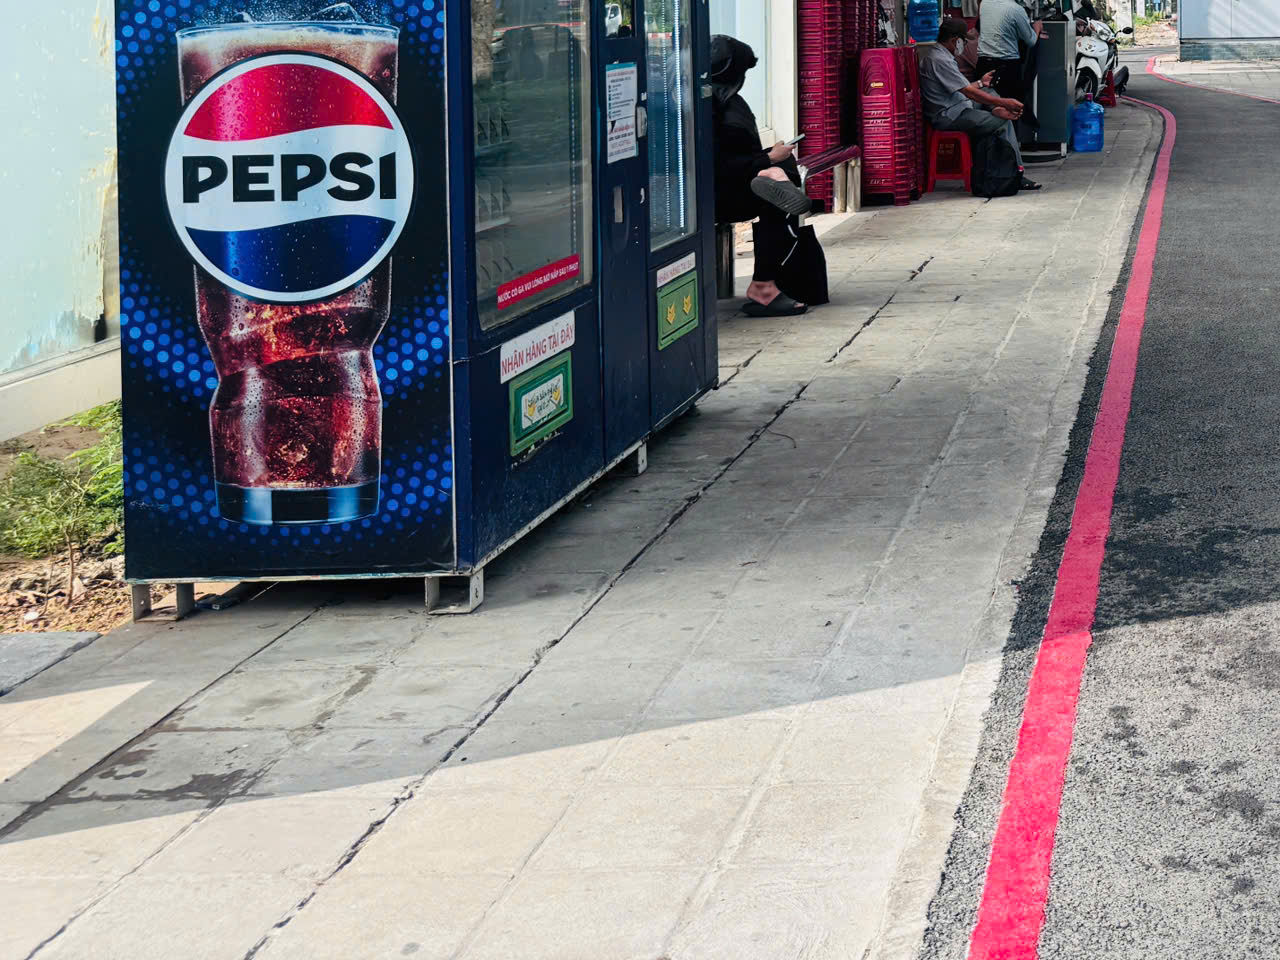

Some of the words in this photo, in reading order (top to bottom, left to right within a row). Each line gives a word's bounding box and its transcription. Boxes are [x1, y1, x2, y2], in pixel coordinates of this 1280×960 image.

[182, 151, 397, 203] PEPSI
[501, 349, 524, 377] NHẬN
[526, 340, 547, 363] HÀNG
[548, 332, 560, 352] TẠI
[560, 322, 574, 344] ĐÂY
